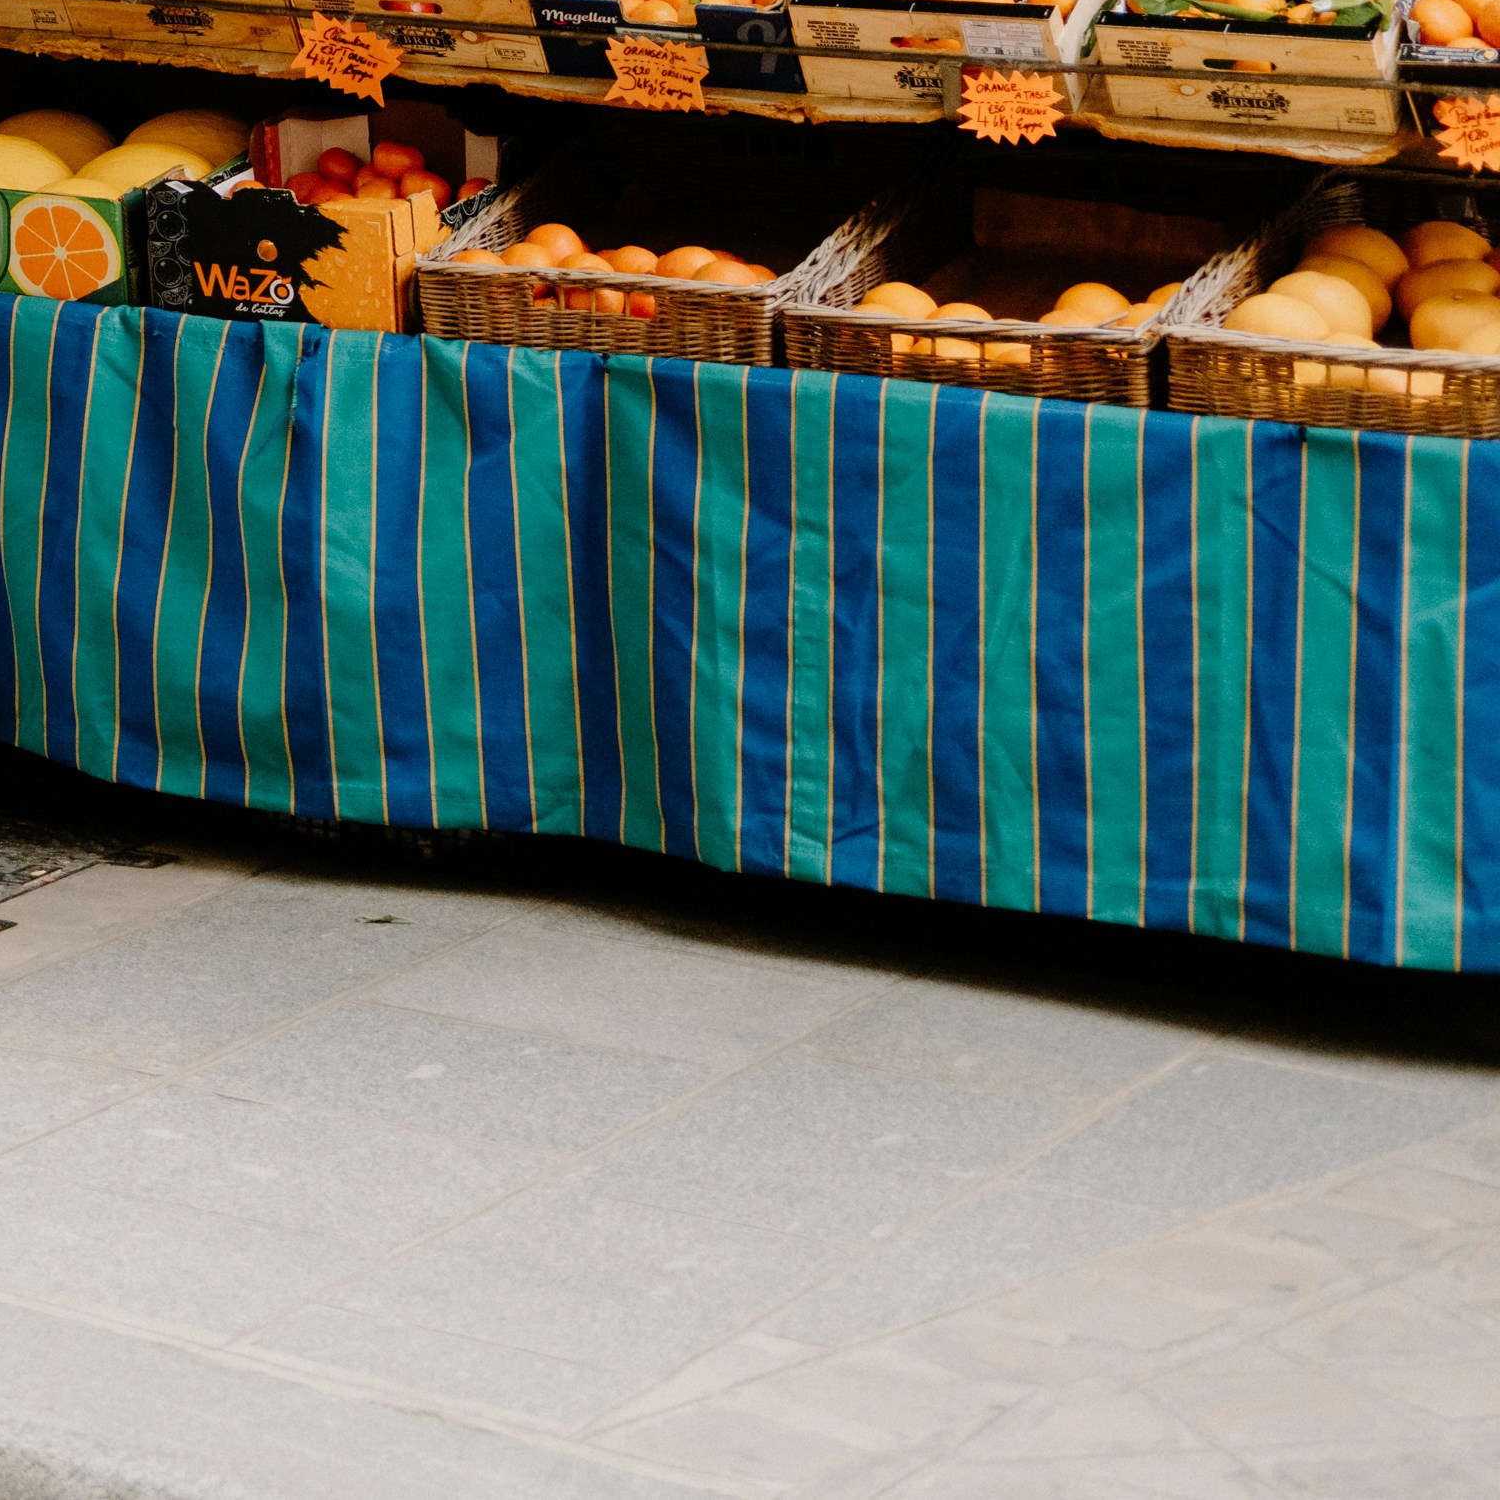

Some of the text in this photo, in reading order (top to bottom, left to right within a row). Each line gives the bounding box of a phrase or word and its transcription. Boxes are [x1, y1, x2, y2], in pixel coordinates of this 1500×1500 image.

[163, 14, 201, 25] BRIO
[542, 8, 617, 25] Magellan
[403, 34, 441, 47] BRIO
[912, 77, 943, 89] BRI
[1022, 90, 1051, 99] TABLE
[1228, 96, 1275, 109] BRIO
